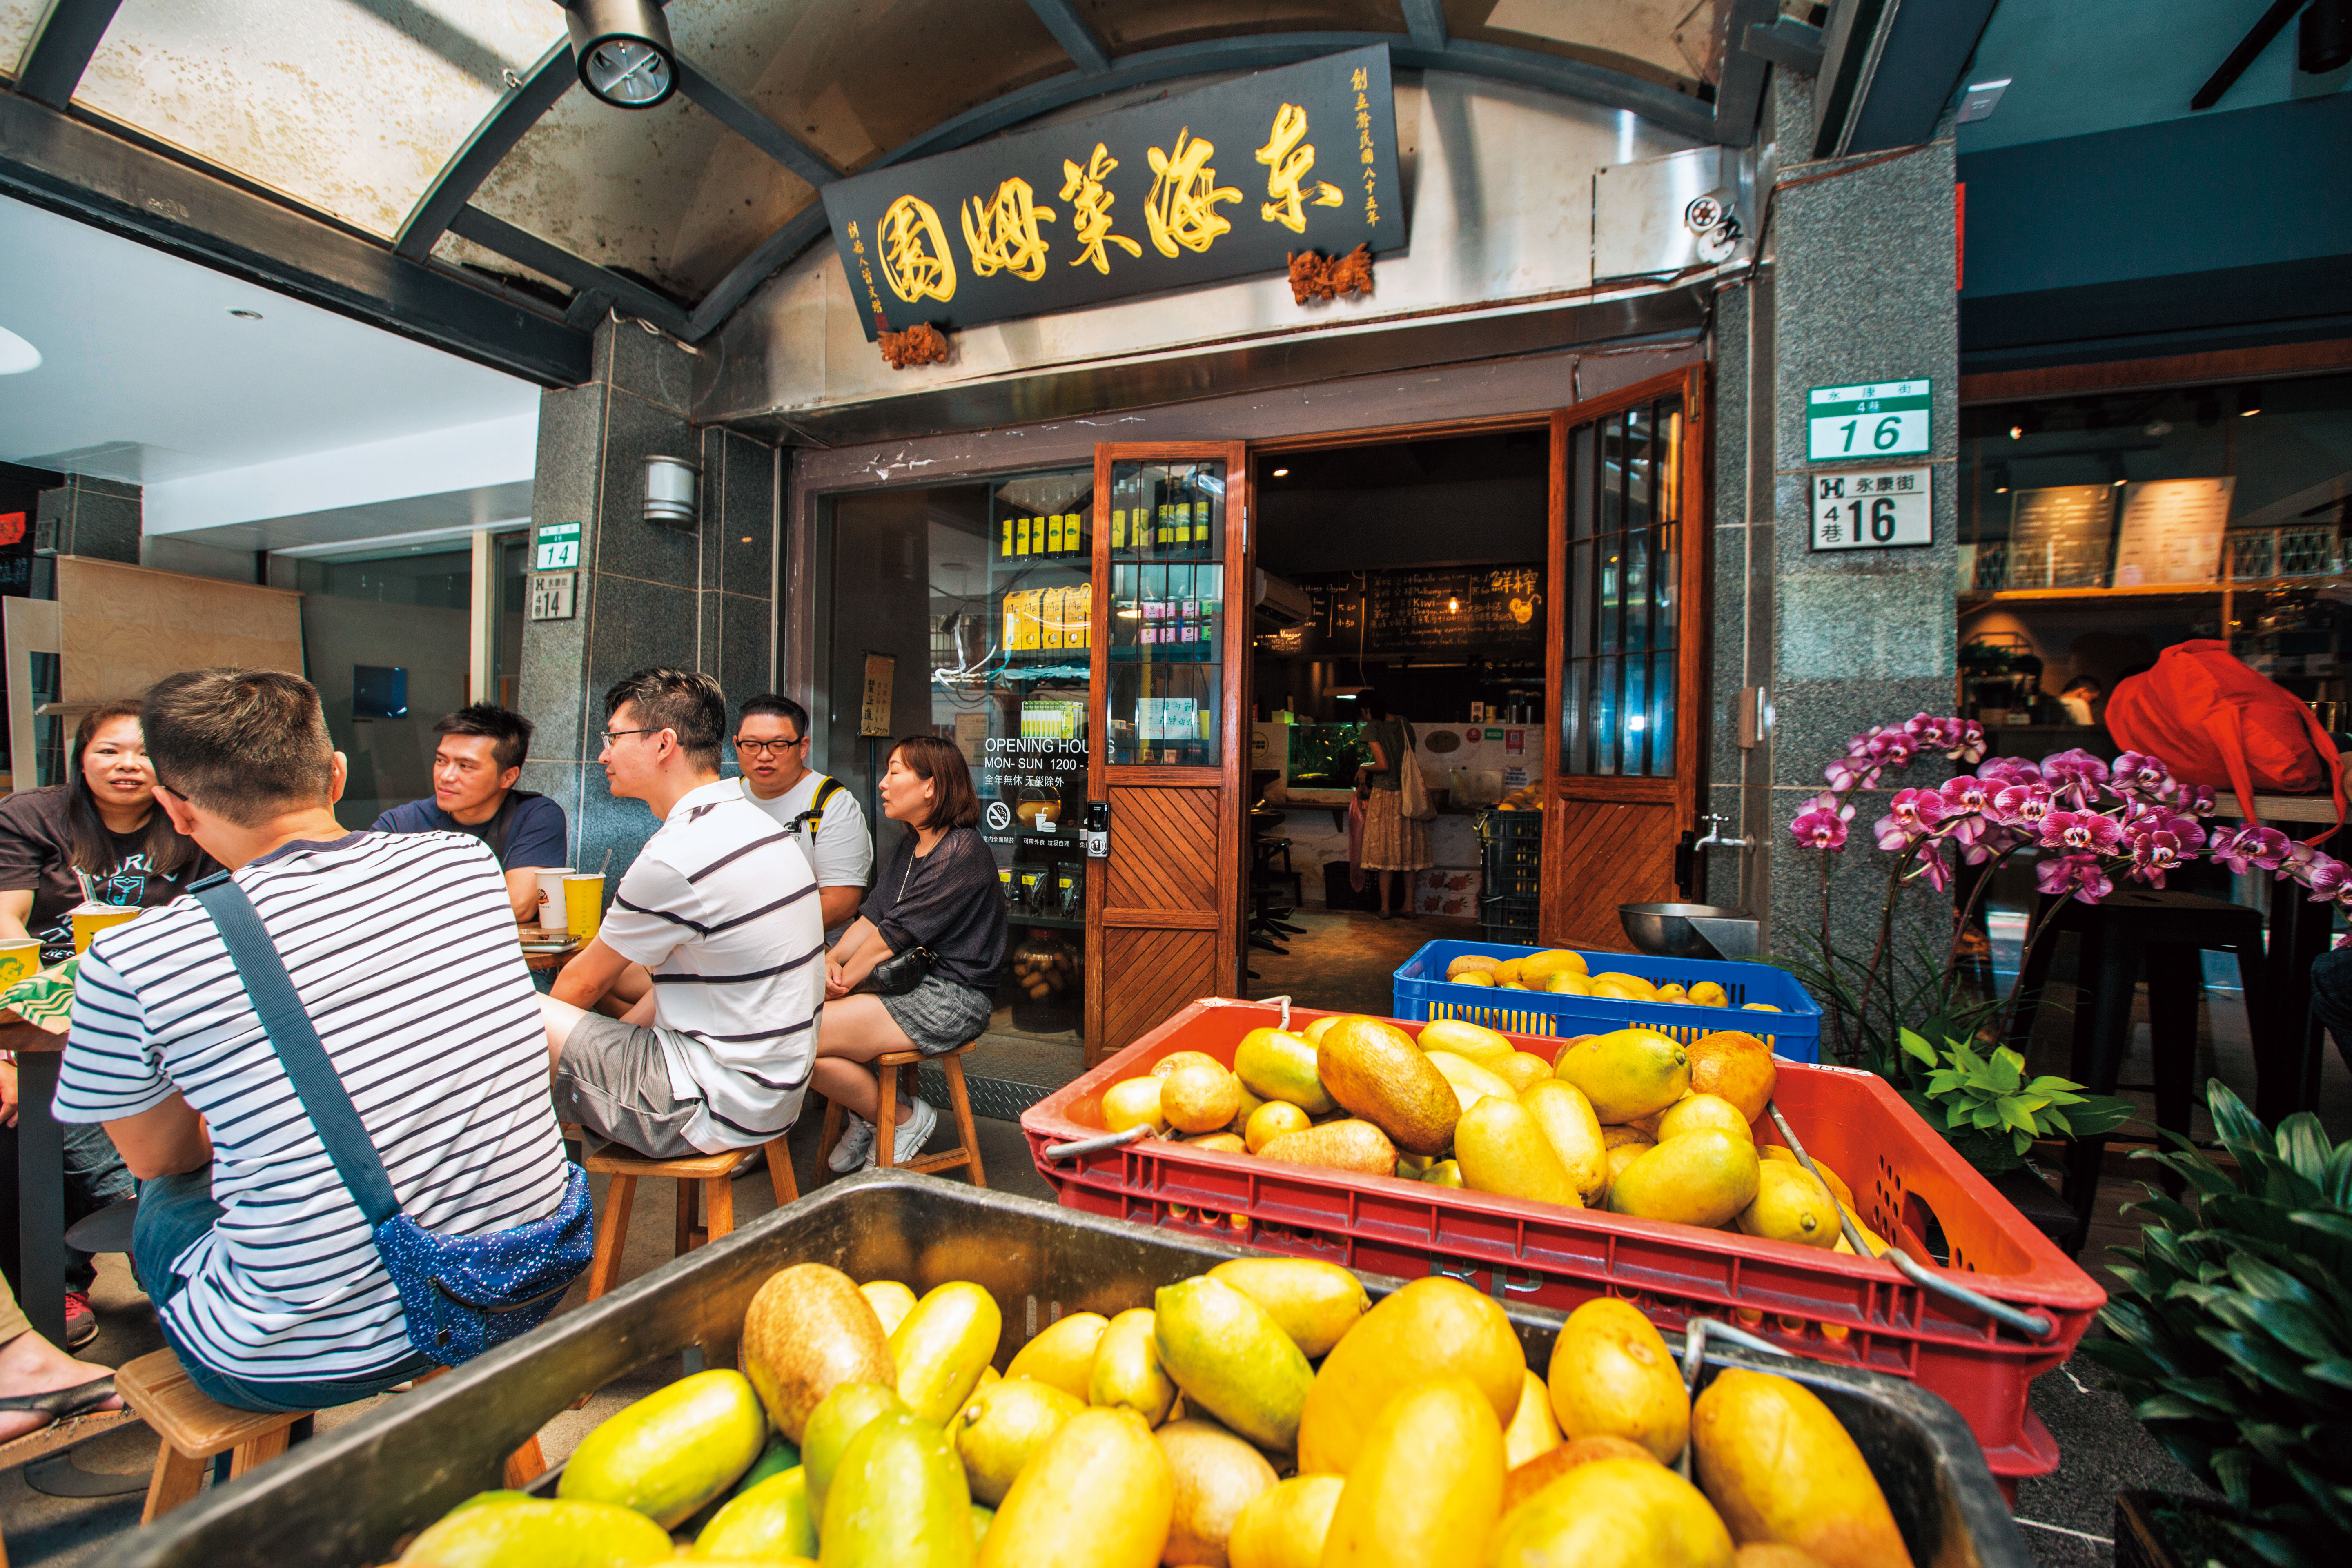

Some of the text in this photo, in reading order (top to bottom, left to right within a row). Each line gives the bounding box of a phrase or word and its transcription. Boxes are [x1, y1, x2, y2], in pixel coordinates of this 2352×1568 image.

[1350, 66, 1380, 228] 創立於民國八十五年
[1828, 383, 1912, 401] 永康街
[1855, 400, 1881, 413] 4巷
[1840, 416, 1902, 452] 16
[1856, 474, 1915, 493] 永康街
[1820, 506, 1843, 543] 4巷
[1847, 497, 1895, 542] 16
[547, 544, 569, 565] 14
[544, 591, 559, 617] 14
[1280, 630, 1301, 640] Vinegar
[985, 738, 1115, 754] OPENING HOUS
[1018, 758, 1042, 769] SUN
[1050, 759, 1076, 771] 1200
[984, 774, 1064, 788] 全年無休 天災除外
[1023, 838, 1045, 846] 可帶外食
